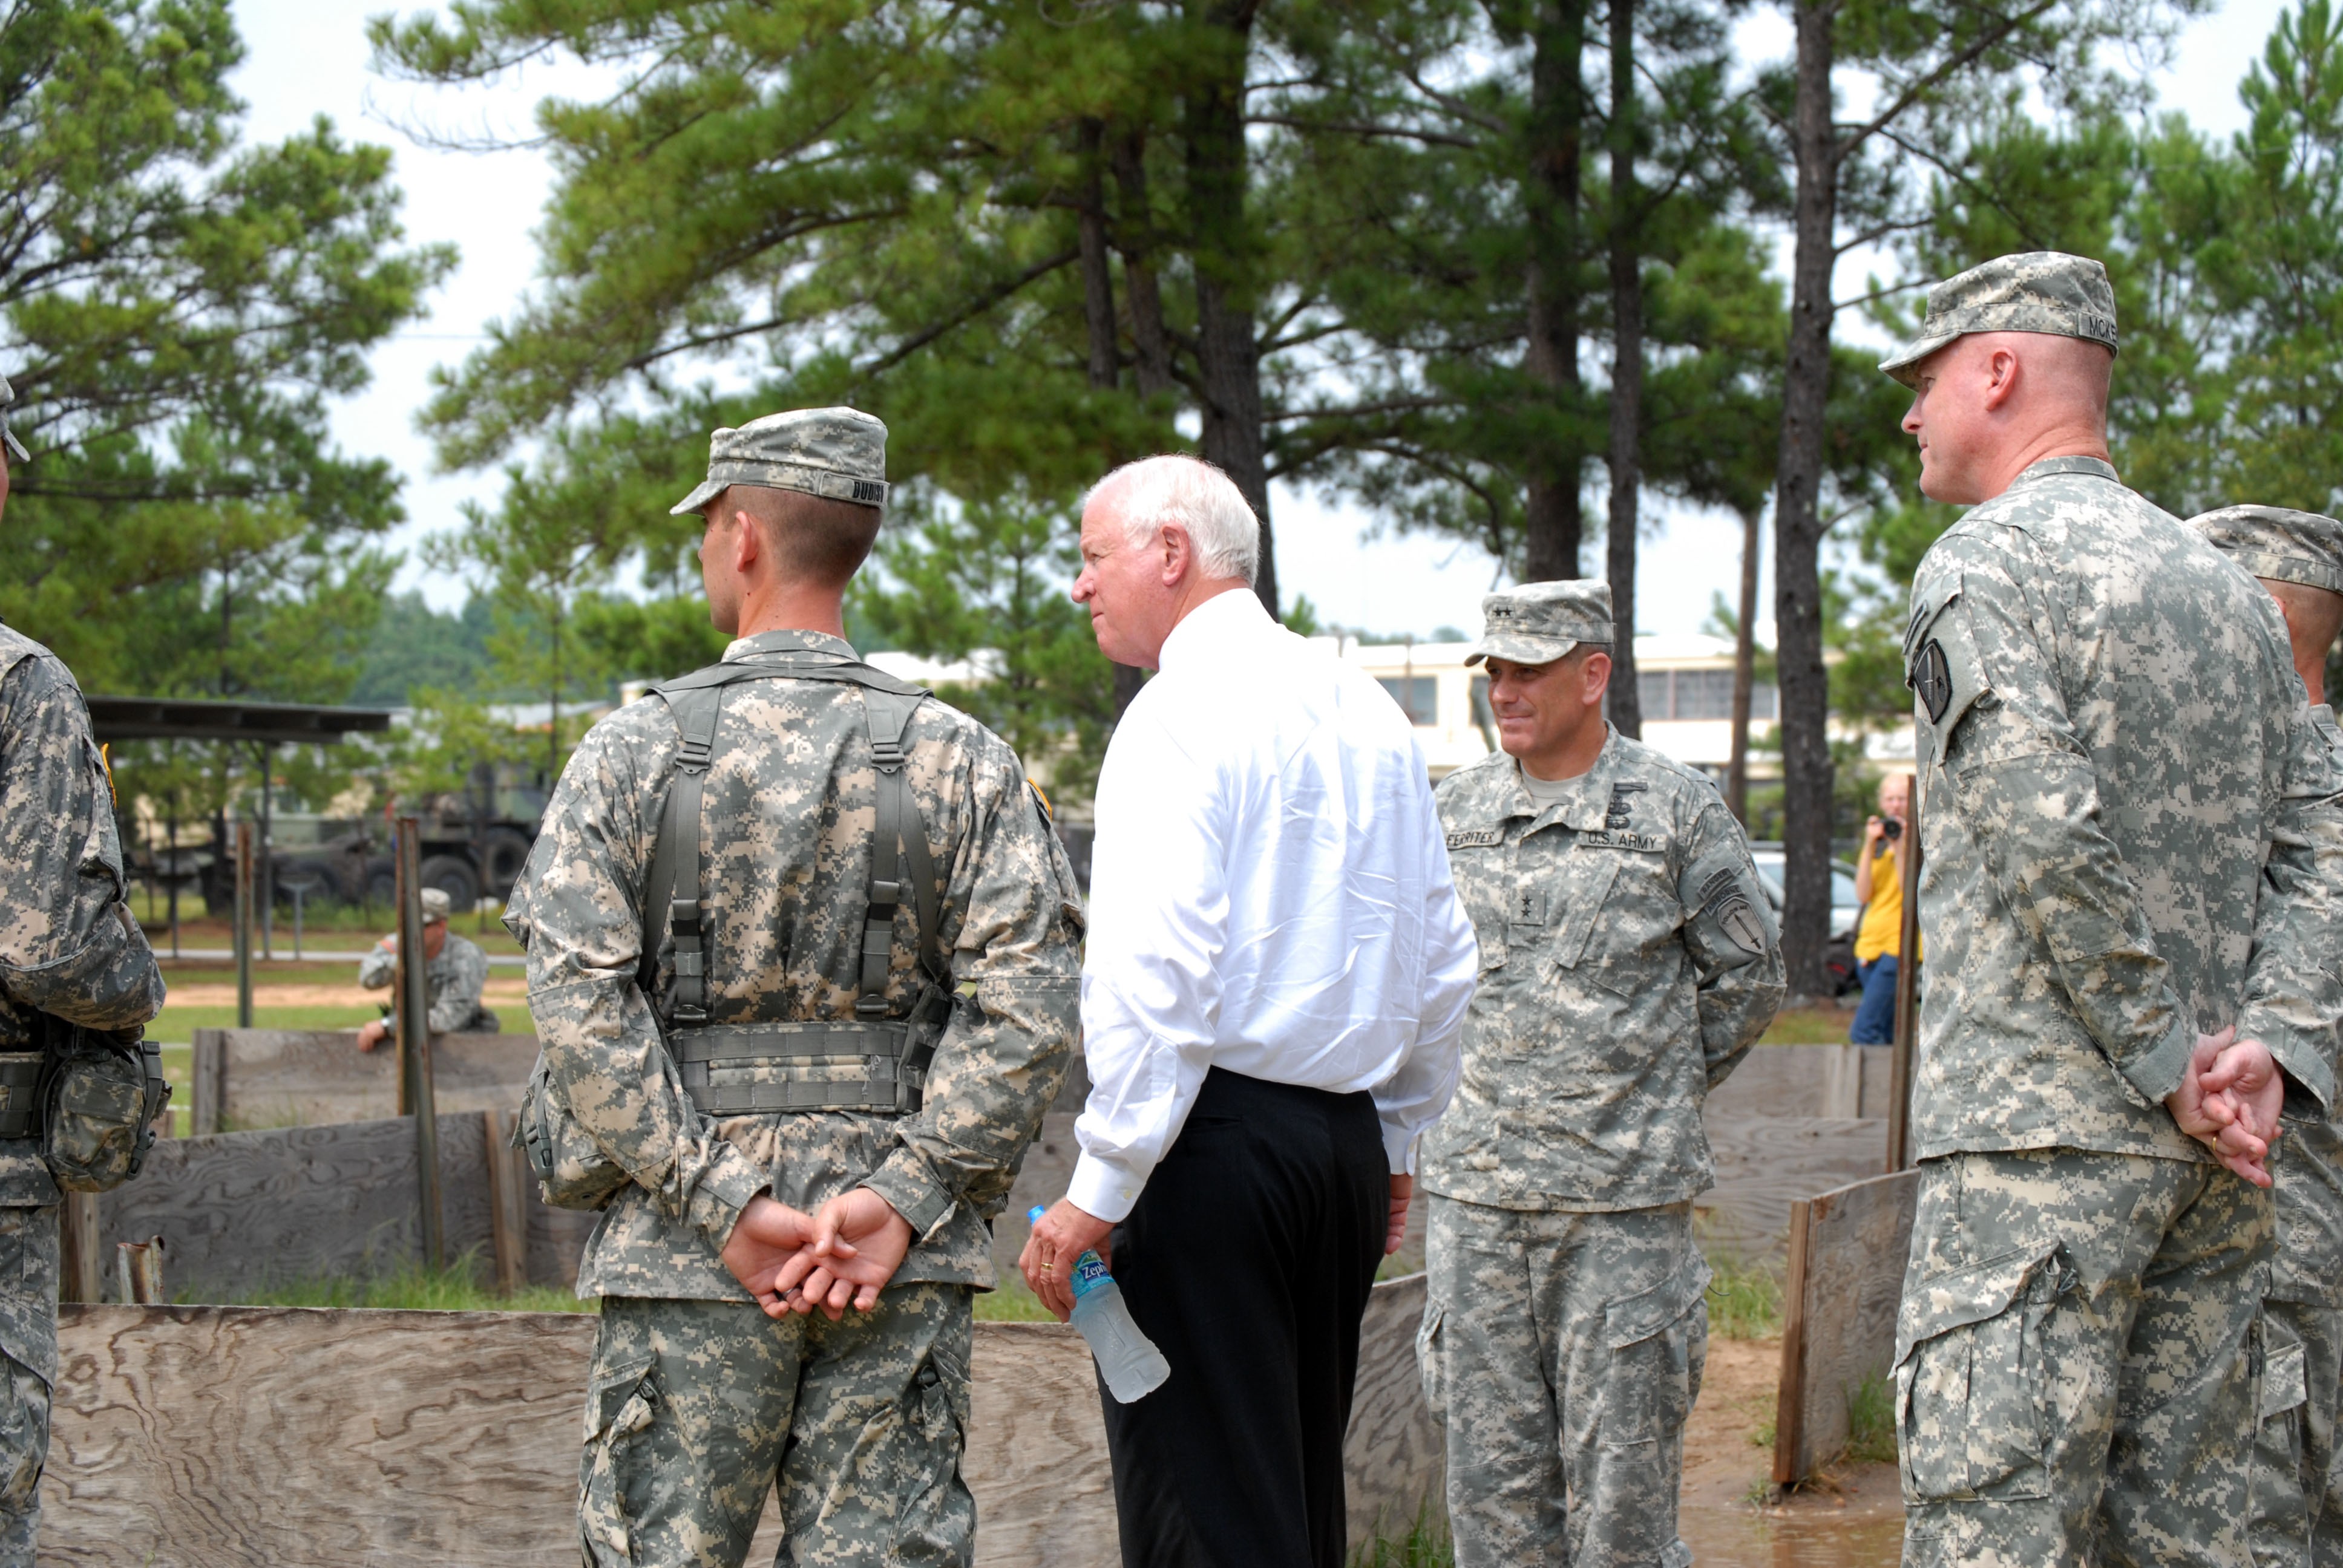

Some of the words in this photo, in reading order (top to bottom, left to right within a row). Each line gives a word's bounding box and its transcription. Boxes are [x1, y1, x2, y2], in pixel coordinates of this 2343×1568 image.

[1446, 831, 1494, 846] FERRITER
[1588, 832, 1614, 845] U.S.
[1618, 834, 1657, 849] ARMY
[1702, 869, 1731, 894] RANGER
[1707, 885, 1741, 913] AIRBORNE
[1722, 907, 1738, 925] FOLLOW
